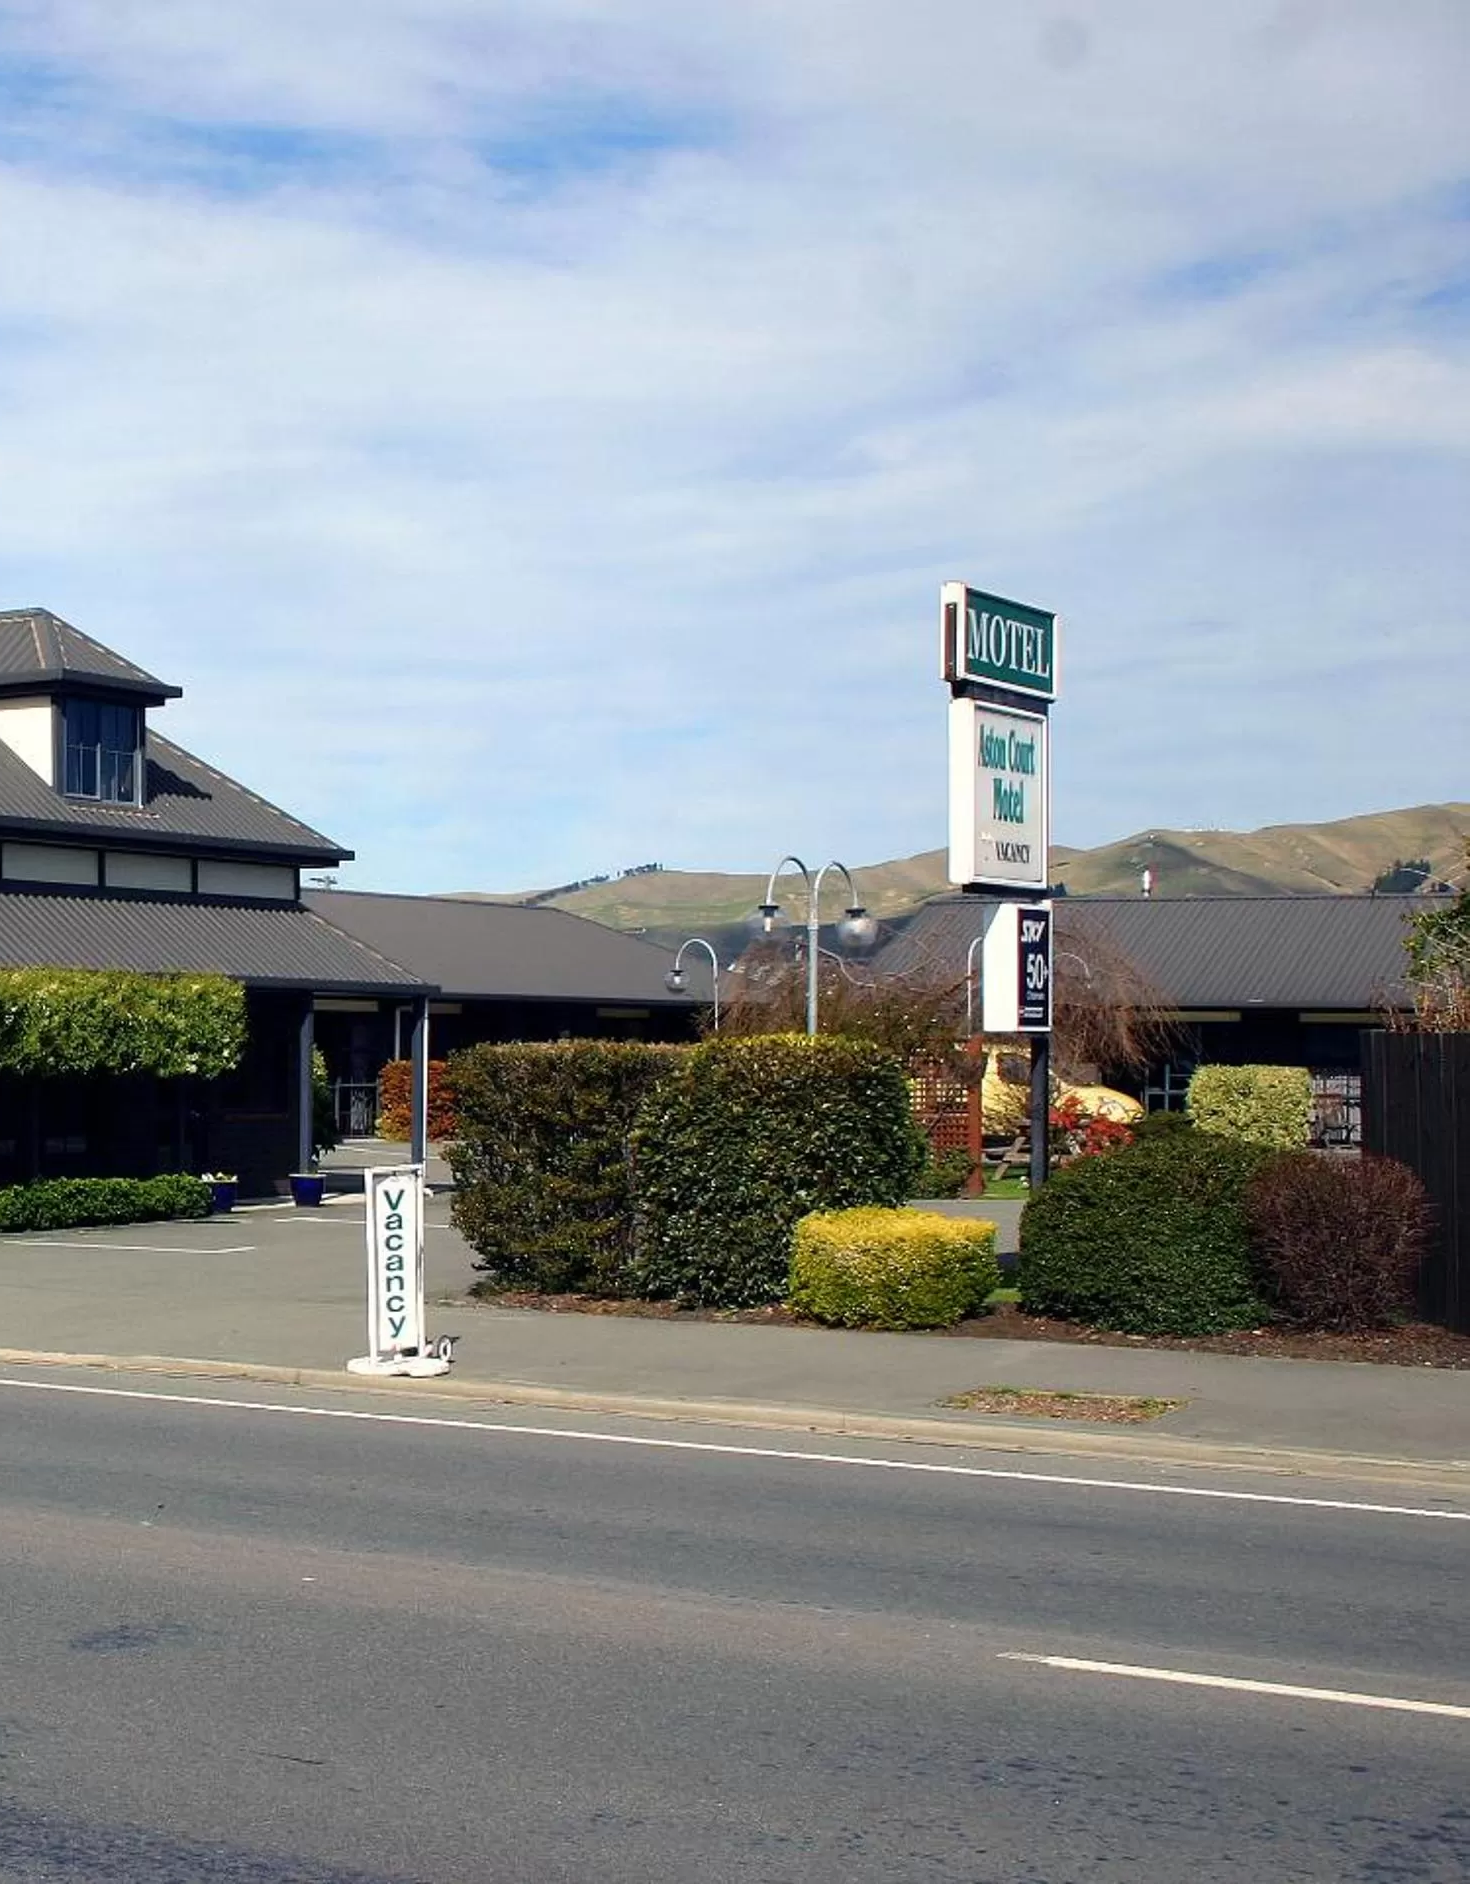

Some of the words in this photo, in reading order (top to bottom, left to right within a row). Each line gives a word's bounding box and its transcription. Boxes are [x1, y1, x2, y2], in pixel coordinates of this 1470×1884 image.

[967, 608, 1050, 678] MOTEL
[978, 724, 1006, 771] Aston
[1009, 729, 1035, 776] Court
[993, 777, 1025, 824] Motel
[995, 841, 1031, 864] VACANCY
[1020, 920, 1046, 943] SKY
[383, 1189, 406, 1339] Vacancy
